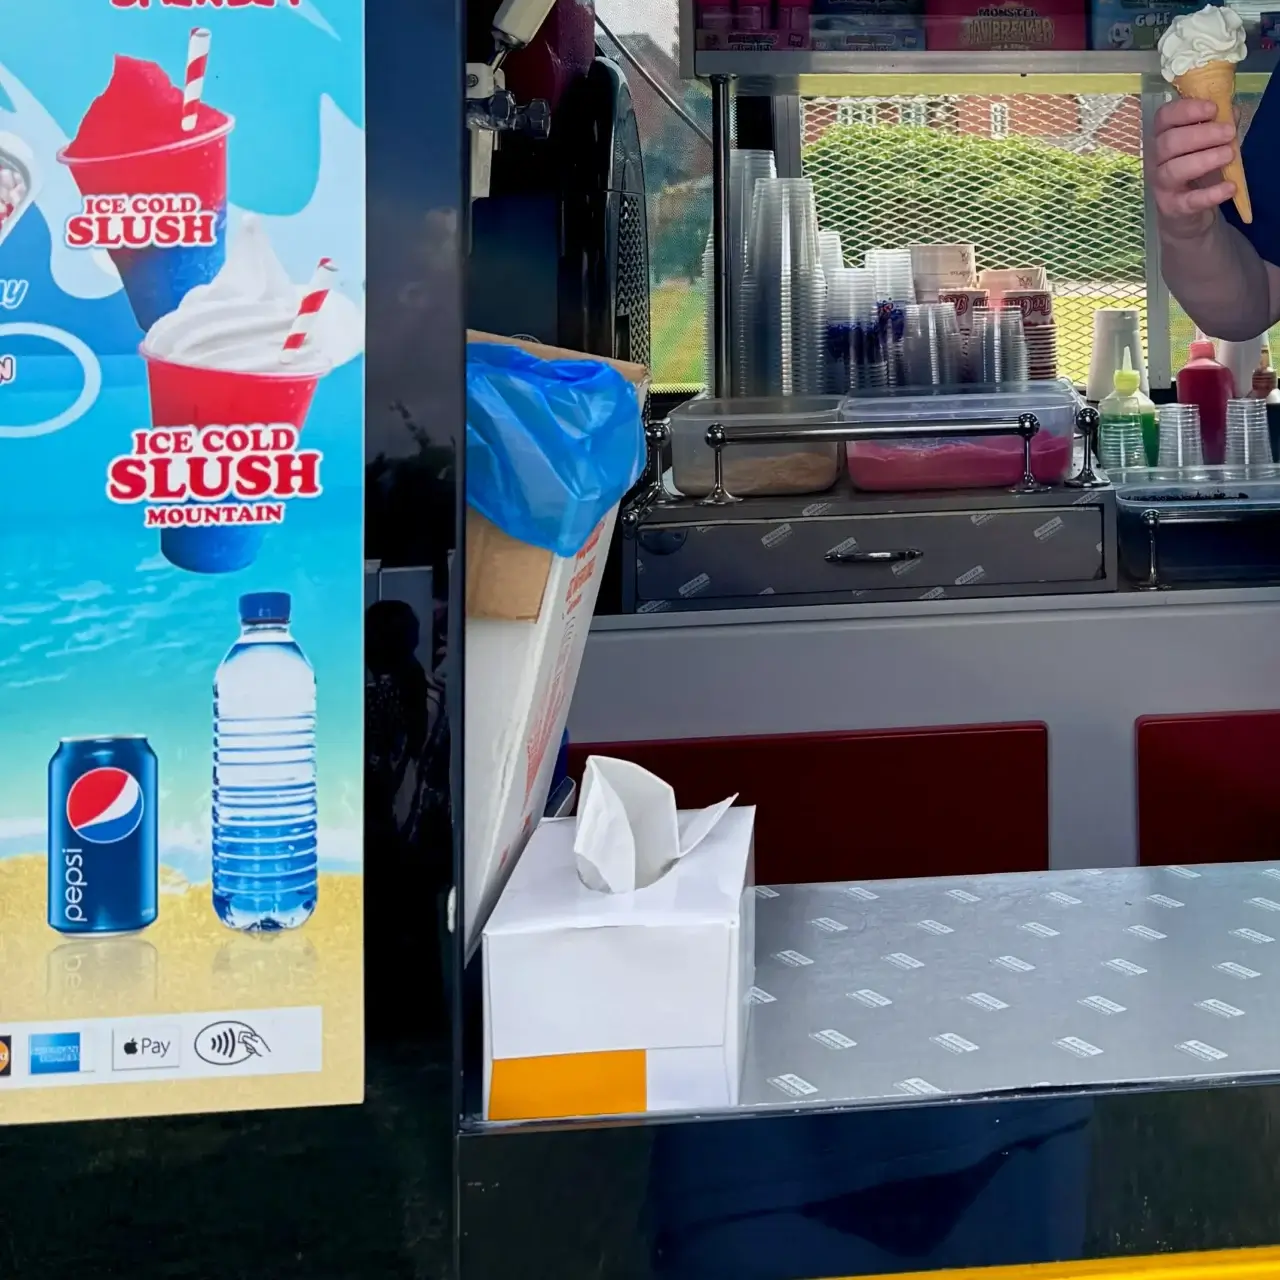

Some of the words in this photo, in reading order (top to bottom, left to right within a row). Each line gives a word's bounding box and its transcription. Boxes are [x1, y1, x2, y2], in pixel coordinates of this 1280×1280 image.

[961, 19, 1055, 44] JAWBREAKER
[1135, 11, 1171, 27] GOLF
[86, 198, 126, 214] ICE
[131, 196, 198, 214] COLD
[67, 215, 214, 246] SLUSH
[135, 431, 194, 456] ICE
[202, 427, 295, 453] COLD
[109, 453, 321, 501] SLUSH
[147, 505, 284, 526] MOUNTAIN
[62, 847, 88, 923] pepsi
[141, 1037, 171, 1057] Pay
